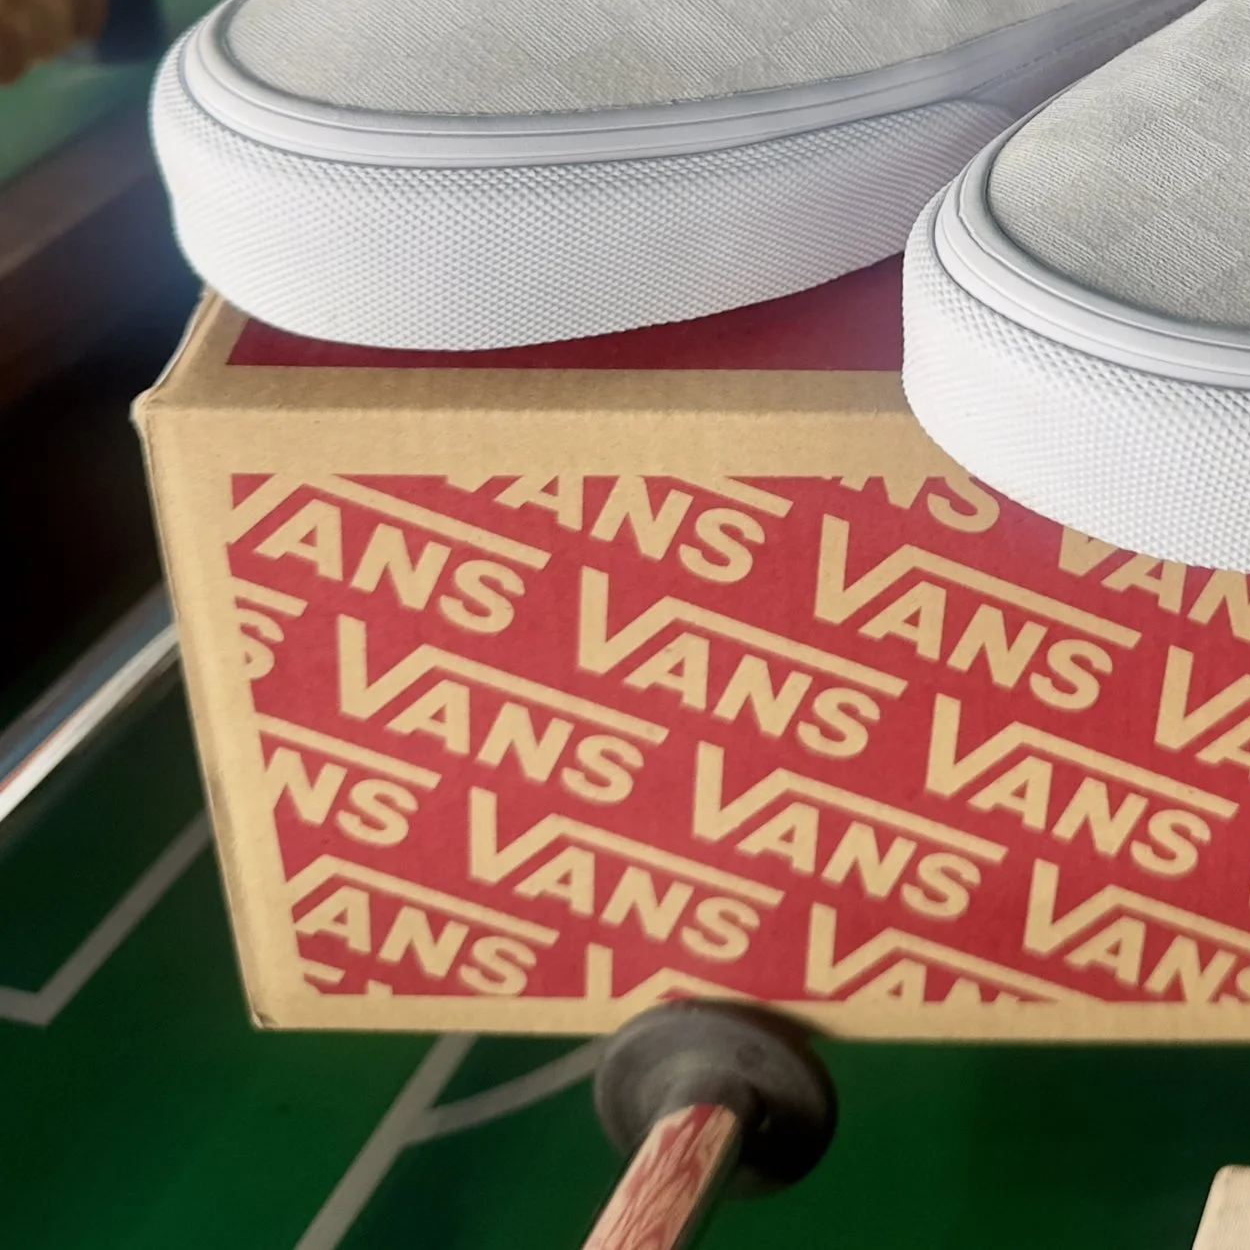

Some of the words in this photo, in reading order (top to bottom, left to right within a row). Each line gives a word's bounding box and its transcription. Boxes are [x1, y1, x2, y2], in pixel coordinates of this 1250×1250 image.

[446, 476, 794, 583] ANS
[813, 513, 1142, 711] VANS
[337, 614, 669, 805] VANS
[577, 566, 908, 759] VANS
[254, 712, 442, 846] NS
[692, 740, 1009, 920] VANS
[924, 693, 1240, 877] VANS
[468, 786, 785, 962] VANS
[805, 902, 1105, 1004] VA
